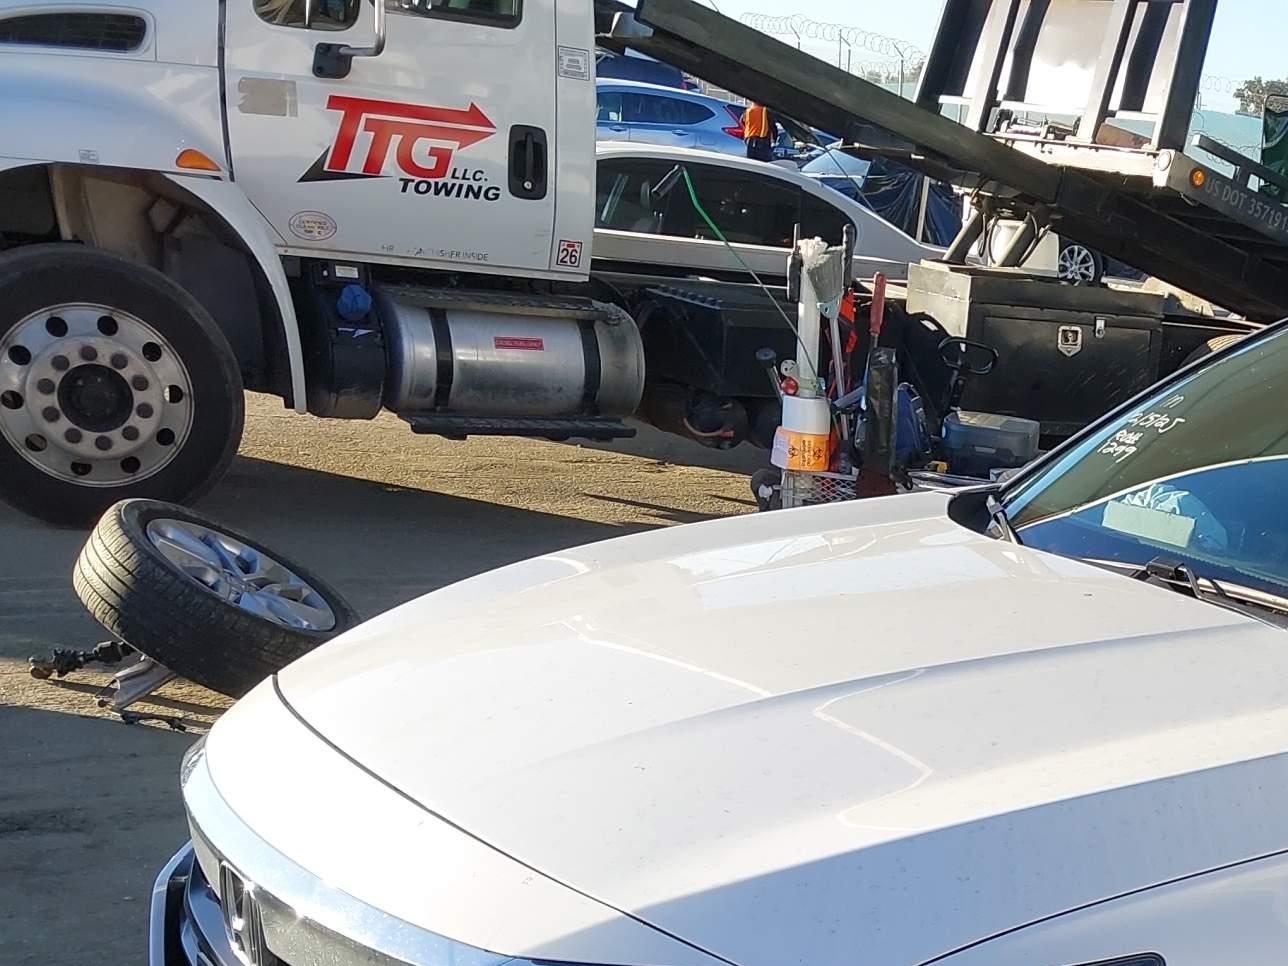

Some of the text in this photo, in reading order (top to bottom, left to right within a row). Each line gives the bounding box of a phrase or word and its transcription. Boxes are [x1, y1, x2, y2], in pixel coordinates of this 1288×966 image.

[326, 95, 497, 179] TTG
[451, 167, 488, 182] LLC.
[399, 177, 501, 201] TOWING
[1205, 179, 1219, 197] US
[1222, 185, 1248, 213] DOT
[560, 247, 578, 265] 26
